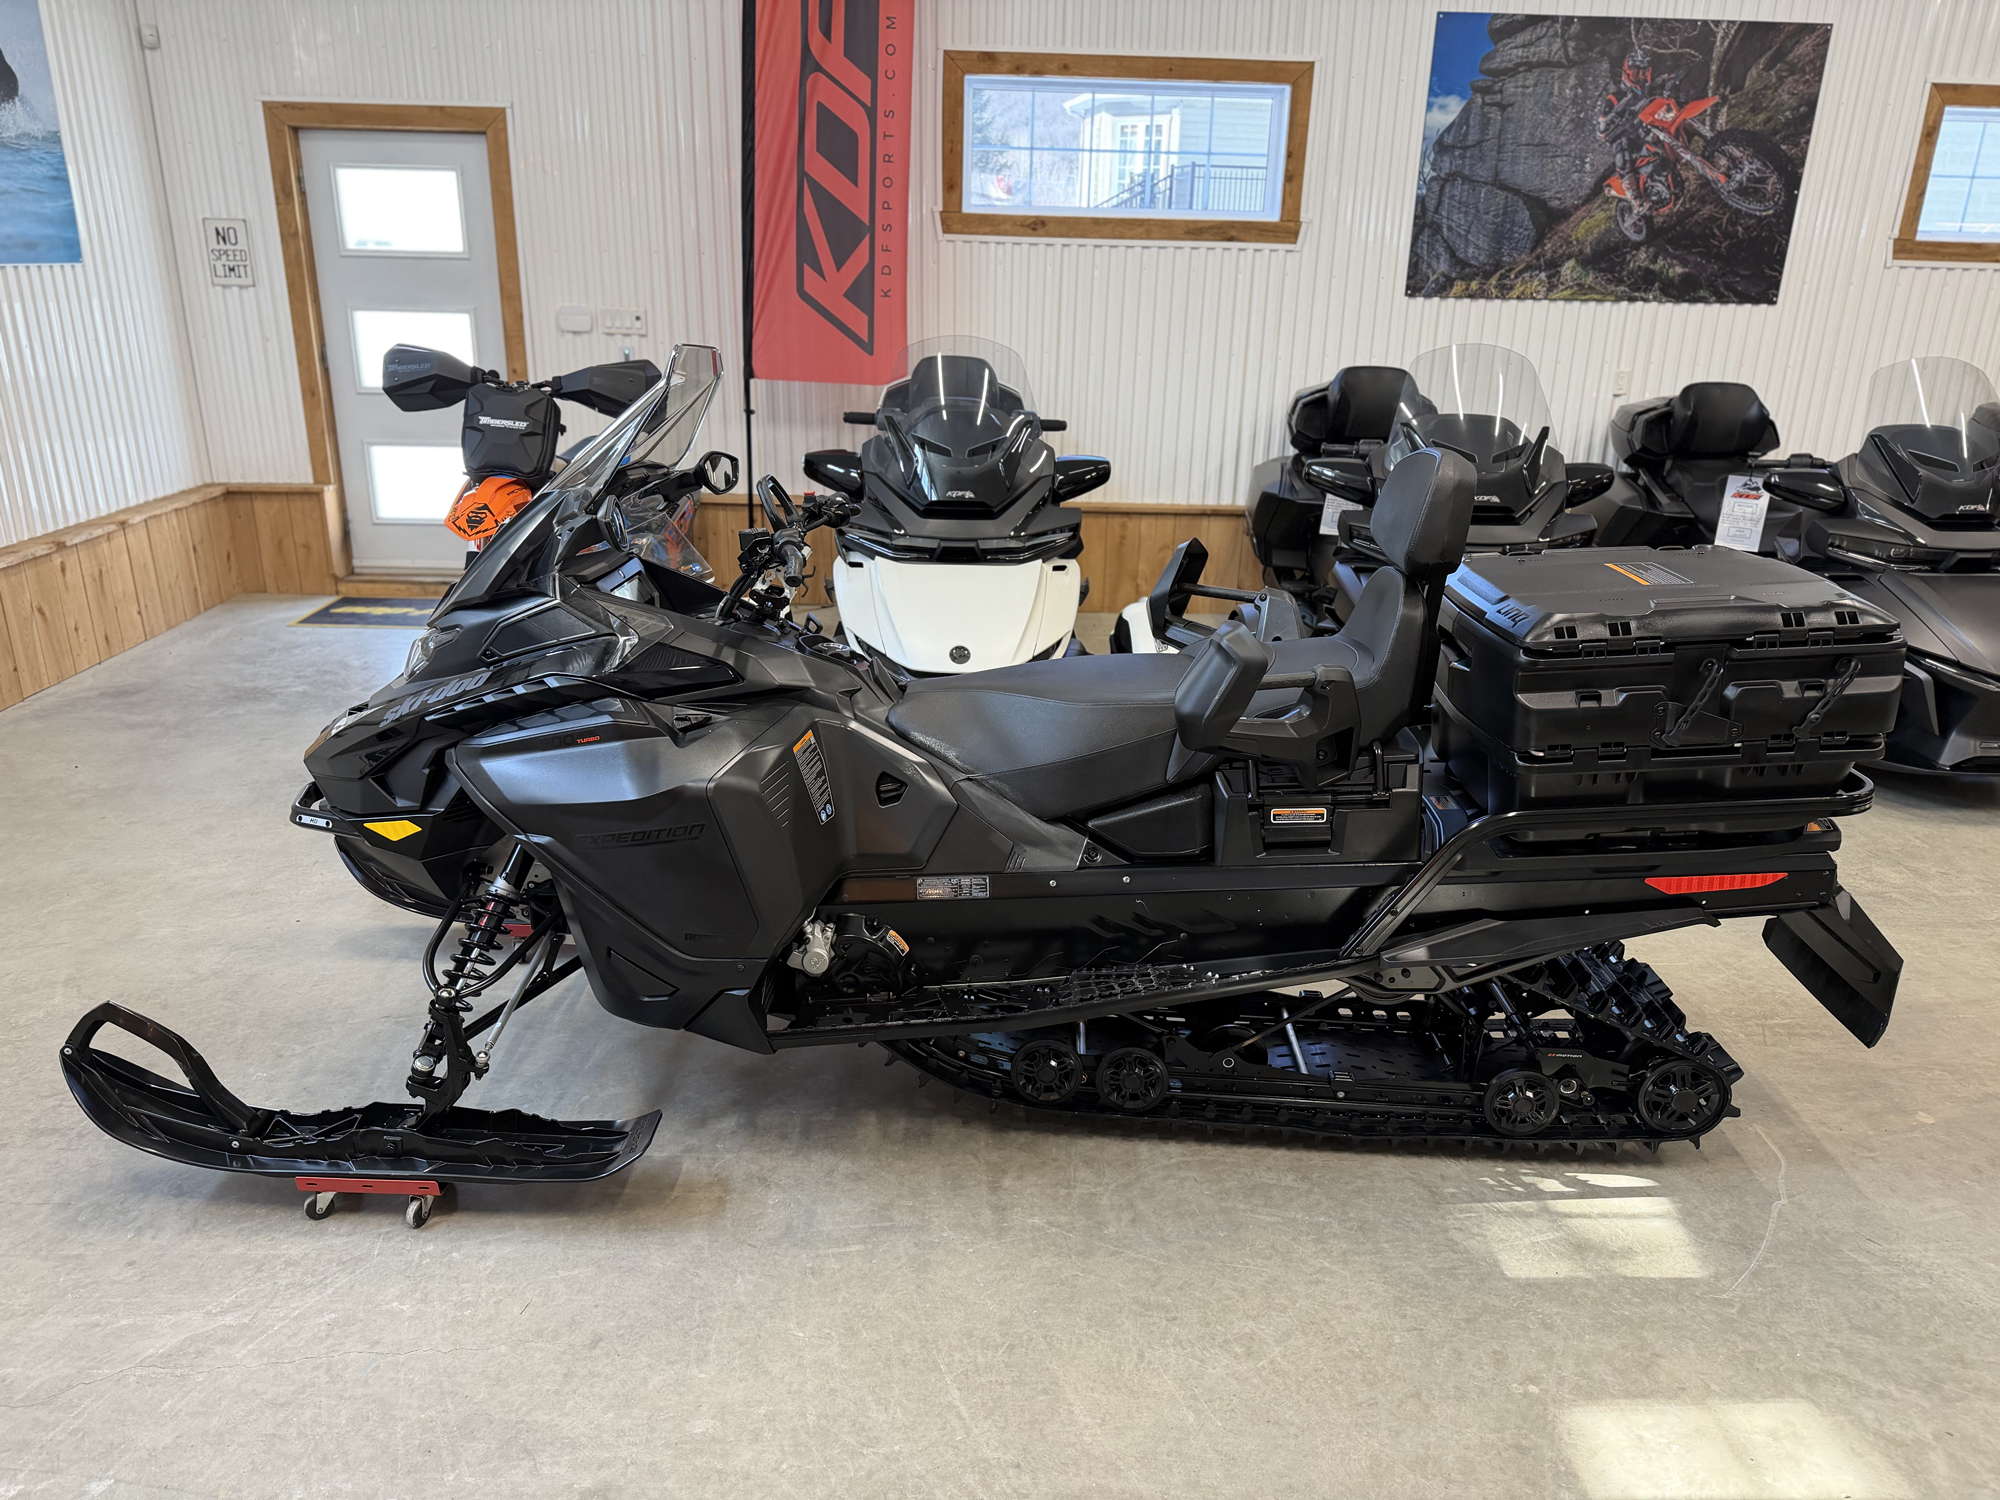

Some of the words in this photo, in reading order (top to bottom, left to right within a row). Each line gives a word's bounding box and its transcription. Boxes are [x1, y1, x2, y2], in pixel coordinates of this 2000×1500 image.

[881, 16, 897, 298] KDFSPORTS.COM
[215, 226, 238, 246] NO
[211, 248, 248, 262] SPEED
[213, 264, 248, 278] LIMIT
[577, 736, 601, 744] TURBO
[577, 823, 706, 845] EXPEDITION
